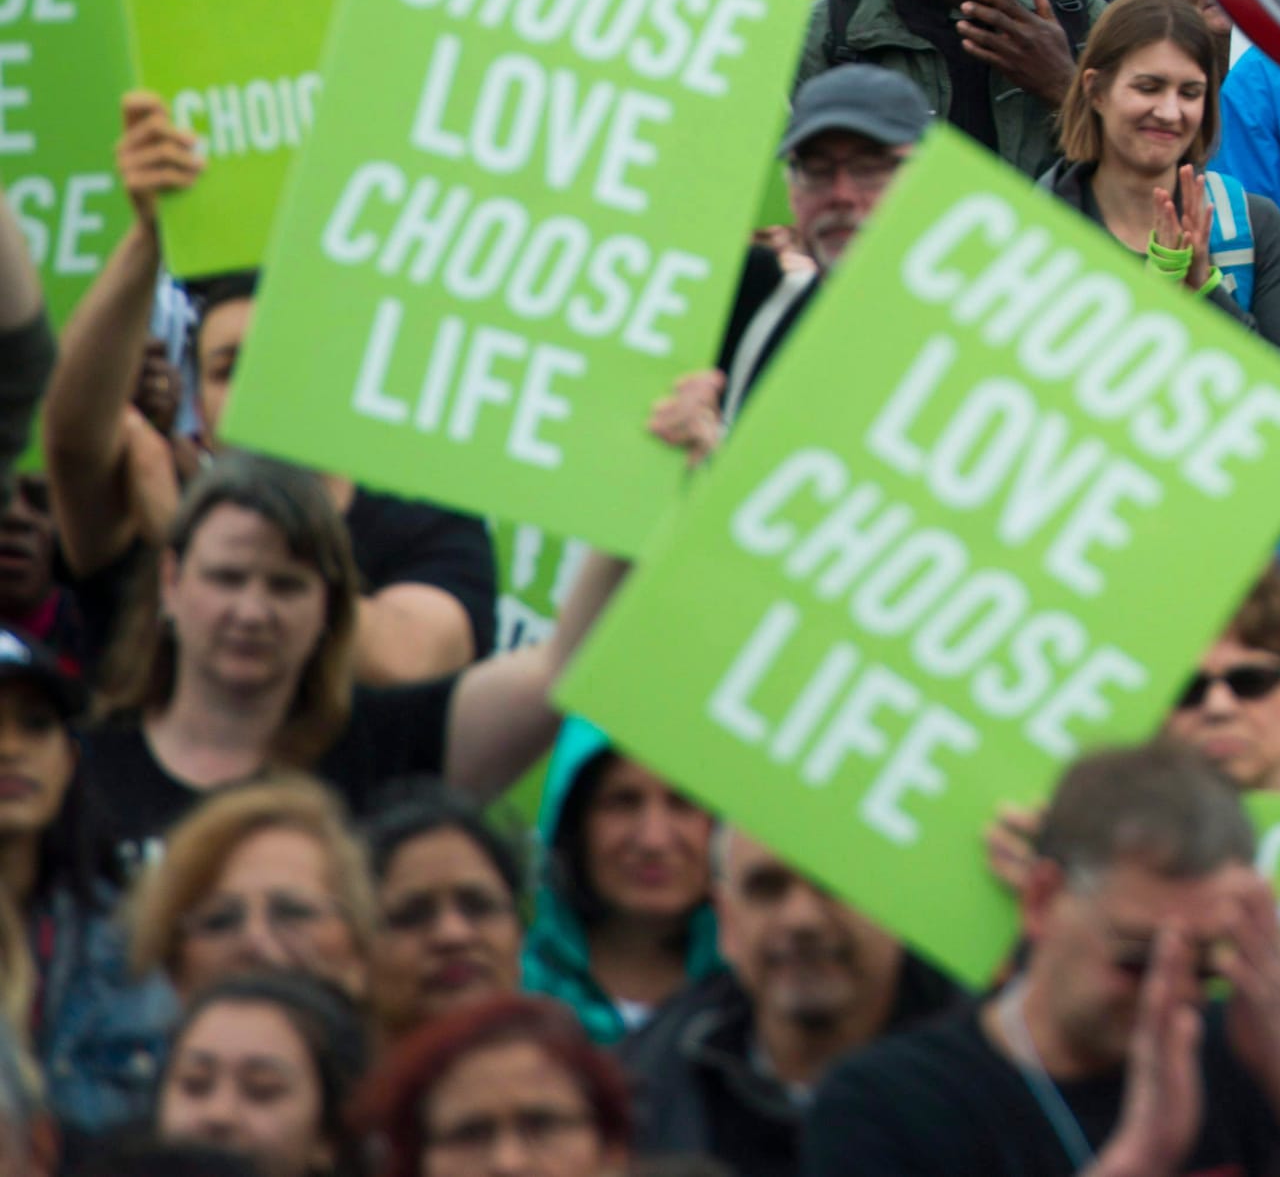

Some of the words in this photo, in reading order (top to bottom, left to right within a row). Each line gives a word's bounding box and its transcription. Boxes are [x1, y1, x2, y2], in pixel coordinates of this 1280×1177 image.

[408, 32, 675, 214] LOVE
[321, 159, 712, 358] CHOOSE
[351, 297, 589, 470] LIFE
[864, 332, 1162, 600] LOVE
[730, 446, 1150, 757] CHOOSE
[706, 598, 980, 848] LIFE
